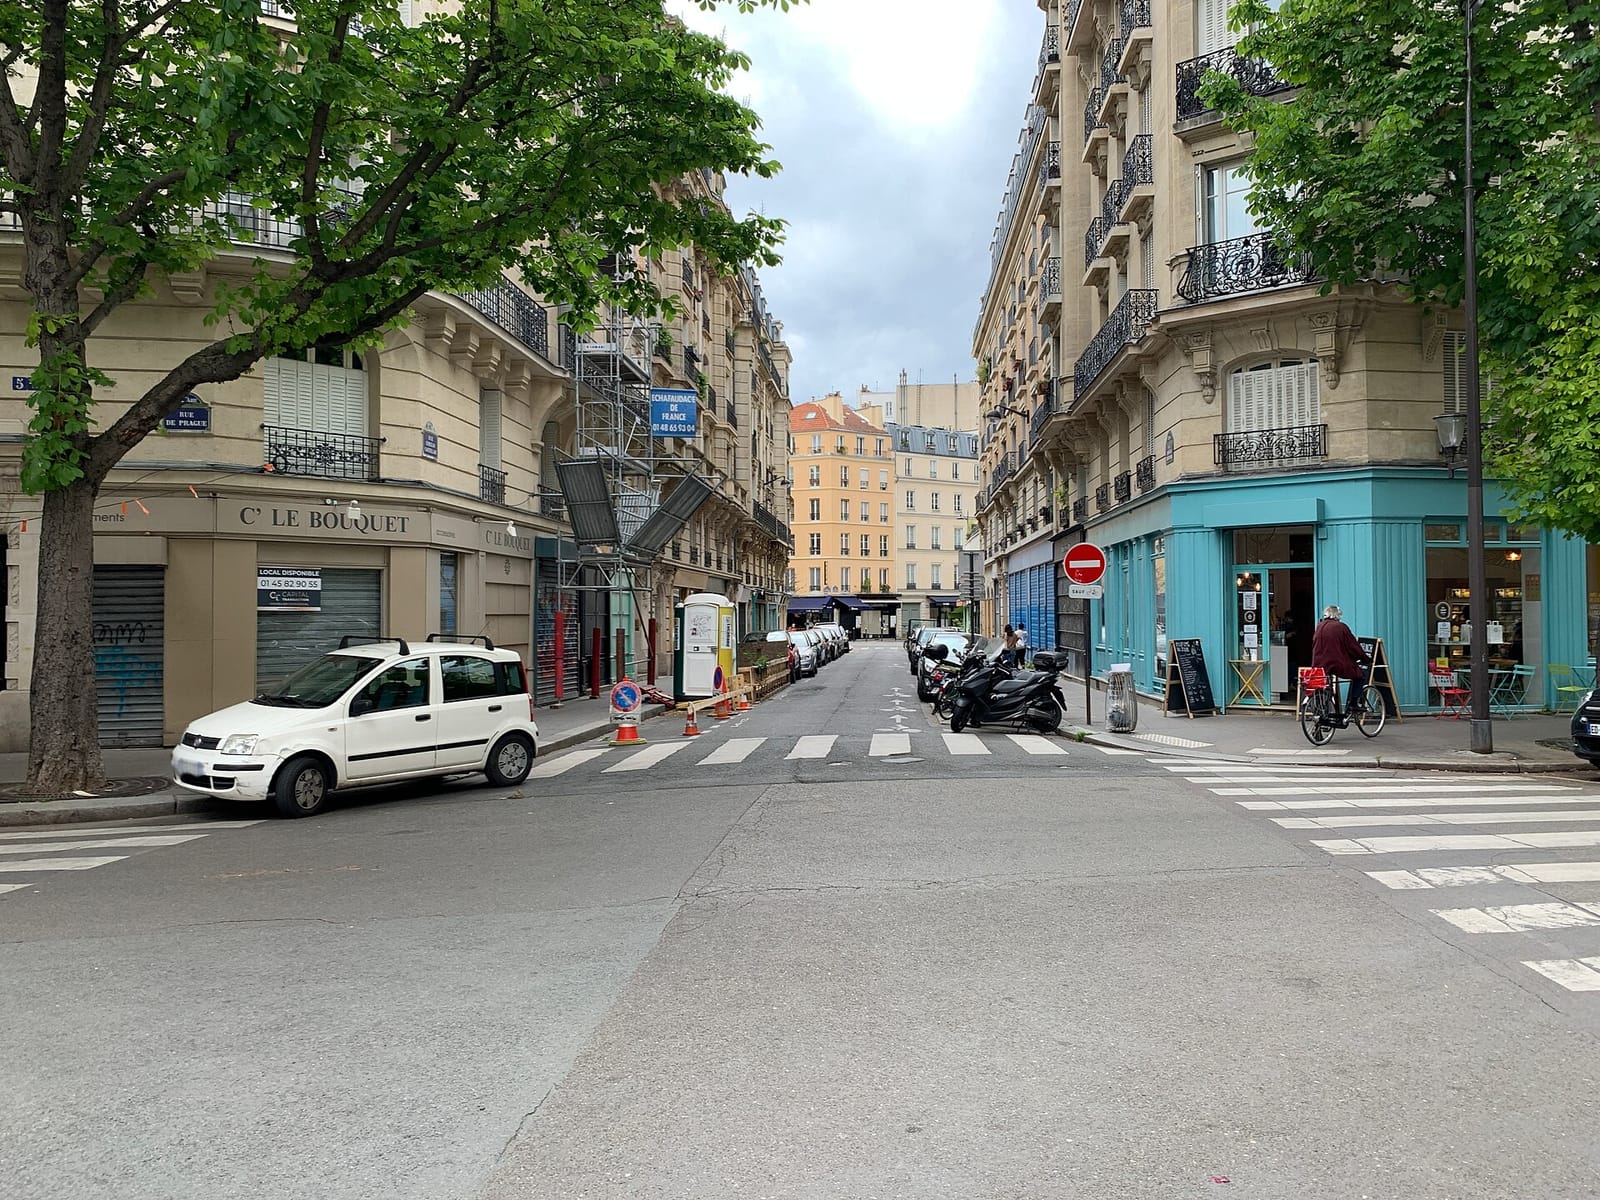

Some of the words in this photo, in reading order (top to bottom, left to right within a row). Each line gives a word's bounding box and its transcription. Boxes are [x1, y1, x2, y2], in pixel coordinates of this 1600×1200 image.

[652, 423, 660, 431] 01
[660, 423, 669, 432] 48
[678, 423, 686, 432] 93
[687, 424, 695, 432] 04
[272, 508, 300, 527] LE
[309, 511, 410, 535] BOUQUET
[281, 569, 320, 577] DISPONIBLE
[260, 579, 270, 587] 01
[271, 579, 282, 587] 45
[283, 579, 295, 588] 82
[295, 580, 307, 588] 90
